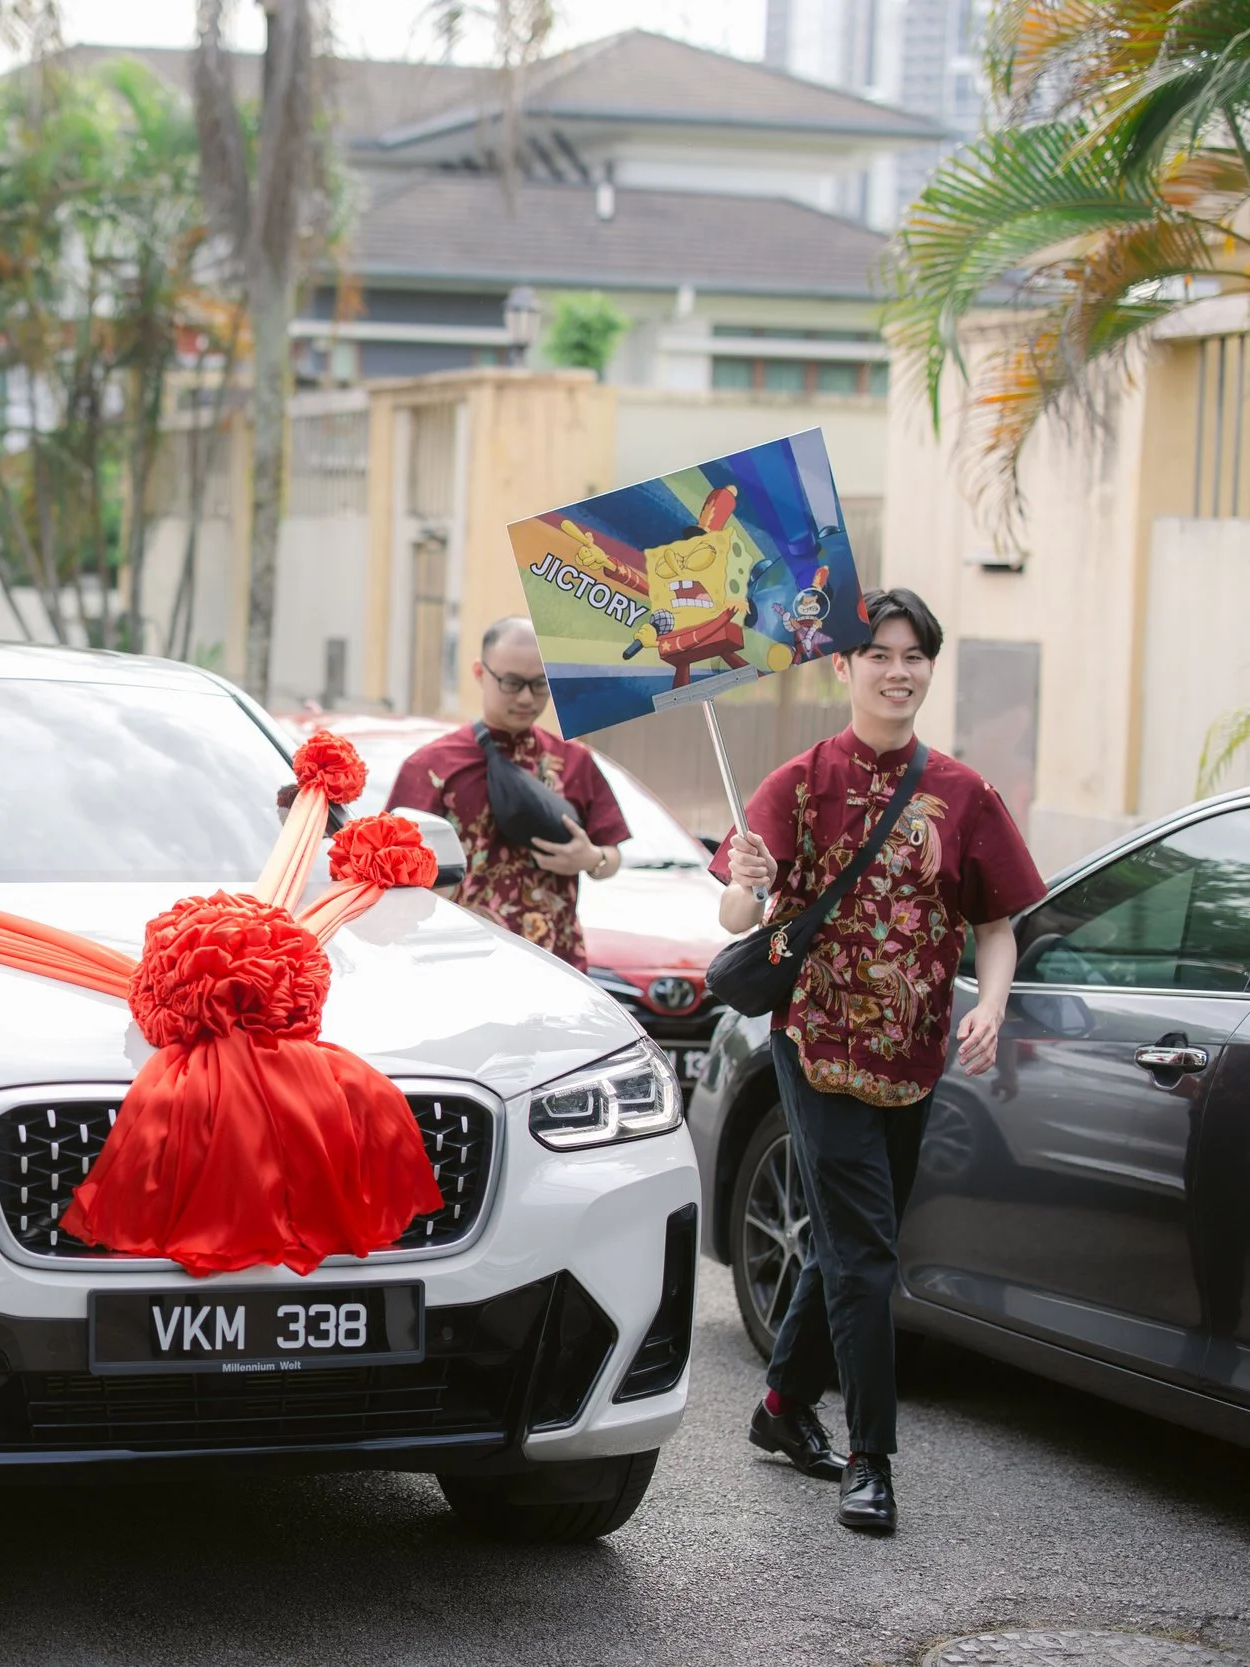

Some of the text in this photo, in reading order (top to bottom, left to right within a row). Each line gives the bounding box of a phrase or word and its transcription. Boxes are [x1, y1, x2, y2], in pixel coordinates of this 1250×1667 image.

[530, 552, 650, 628] JICTORY
[152, 1303, 367, 1350] VKM 338
[222, 1360, 301, 1373] Millennium Welt
